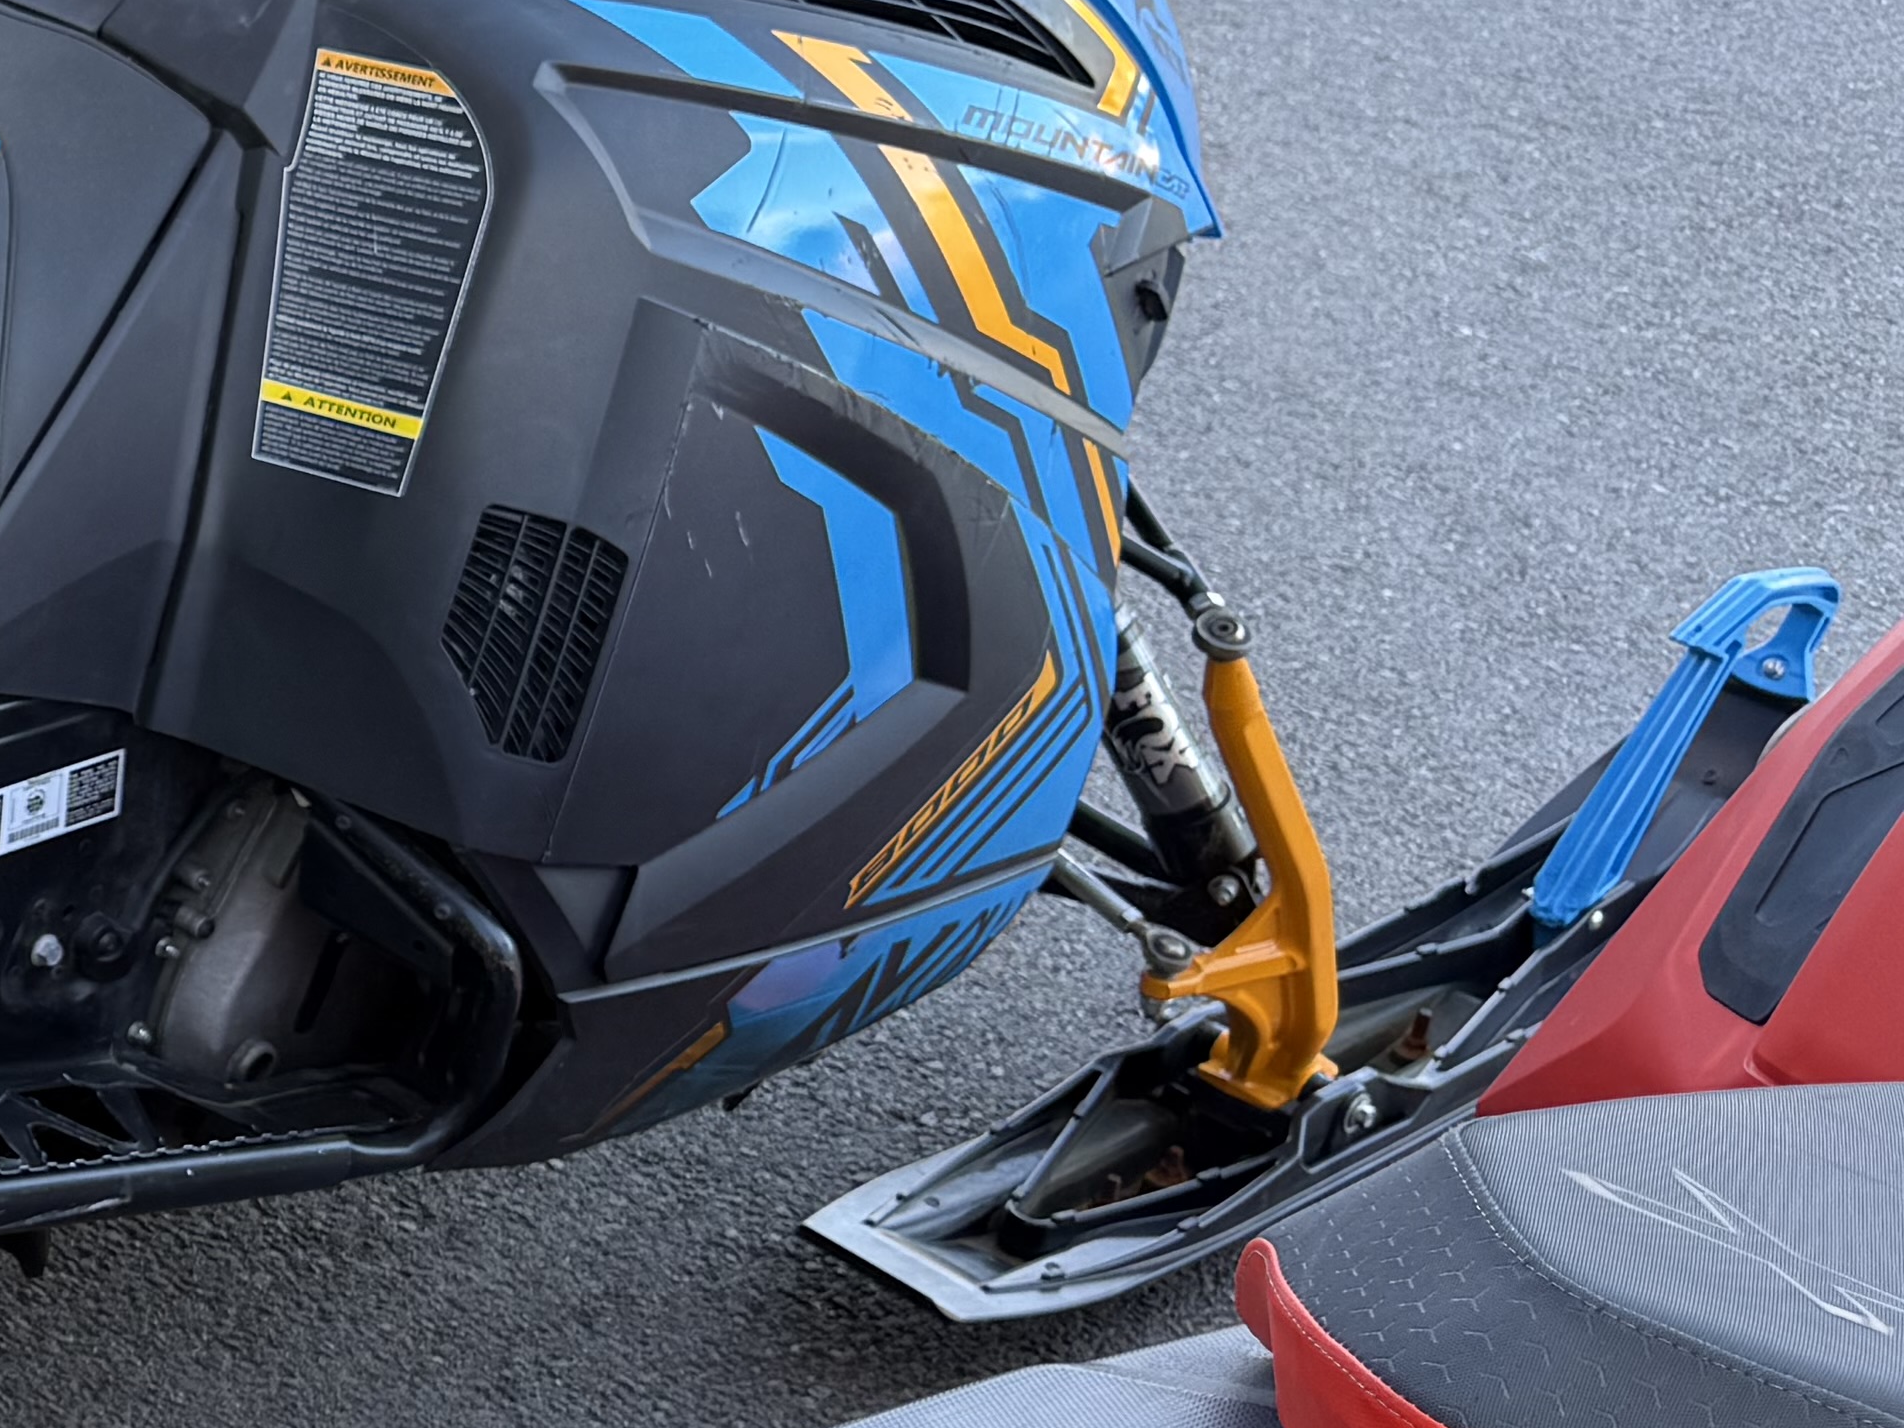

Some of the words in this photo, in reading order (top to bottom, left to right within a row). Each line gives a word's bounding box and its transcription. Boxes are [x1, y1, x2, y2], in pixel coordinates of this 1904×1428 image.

[336, 59, 436, 89] AVERTISSEMENT
[961, 104, 1159, 186] MOUNTAIN
[302, 395, 398, 429] ATTENTION
